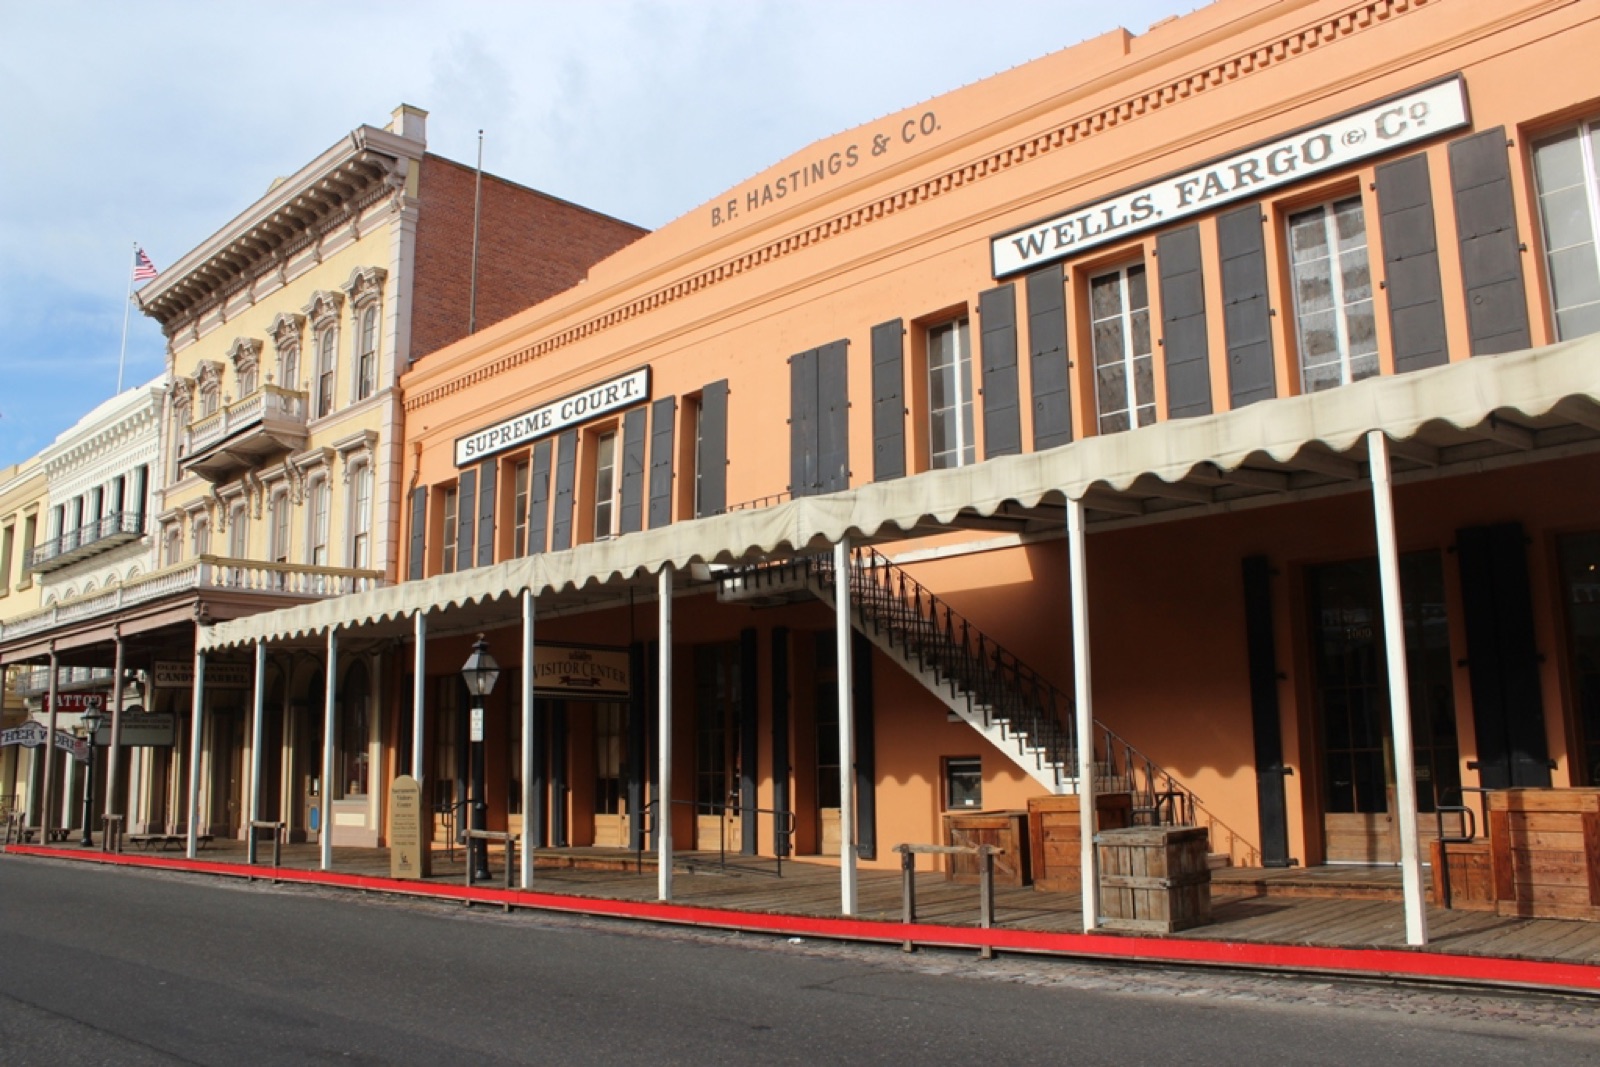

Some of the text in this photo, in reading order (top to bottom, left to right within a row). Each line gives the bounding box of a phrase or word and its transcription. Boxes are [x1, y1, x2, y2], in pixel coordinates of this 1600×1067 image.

[746, 144, 859, 212] HASTINGS
[871, 133, 891, 156] &
[902, 111, 942, 144] CO.
[1011, 193, 1163, 260] WELLS,
[1174, 133, 1333, 208] FARGO
[465, 377, 639, 457] SUPREME COURT.
[181, 664, 249, 673] SAAMENTO
[533, 661, 627, 684] VISITOR CENTER
[44, 694, 103, 707] TATTOO
